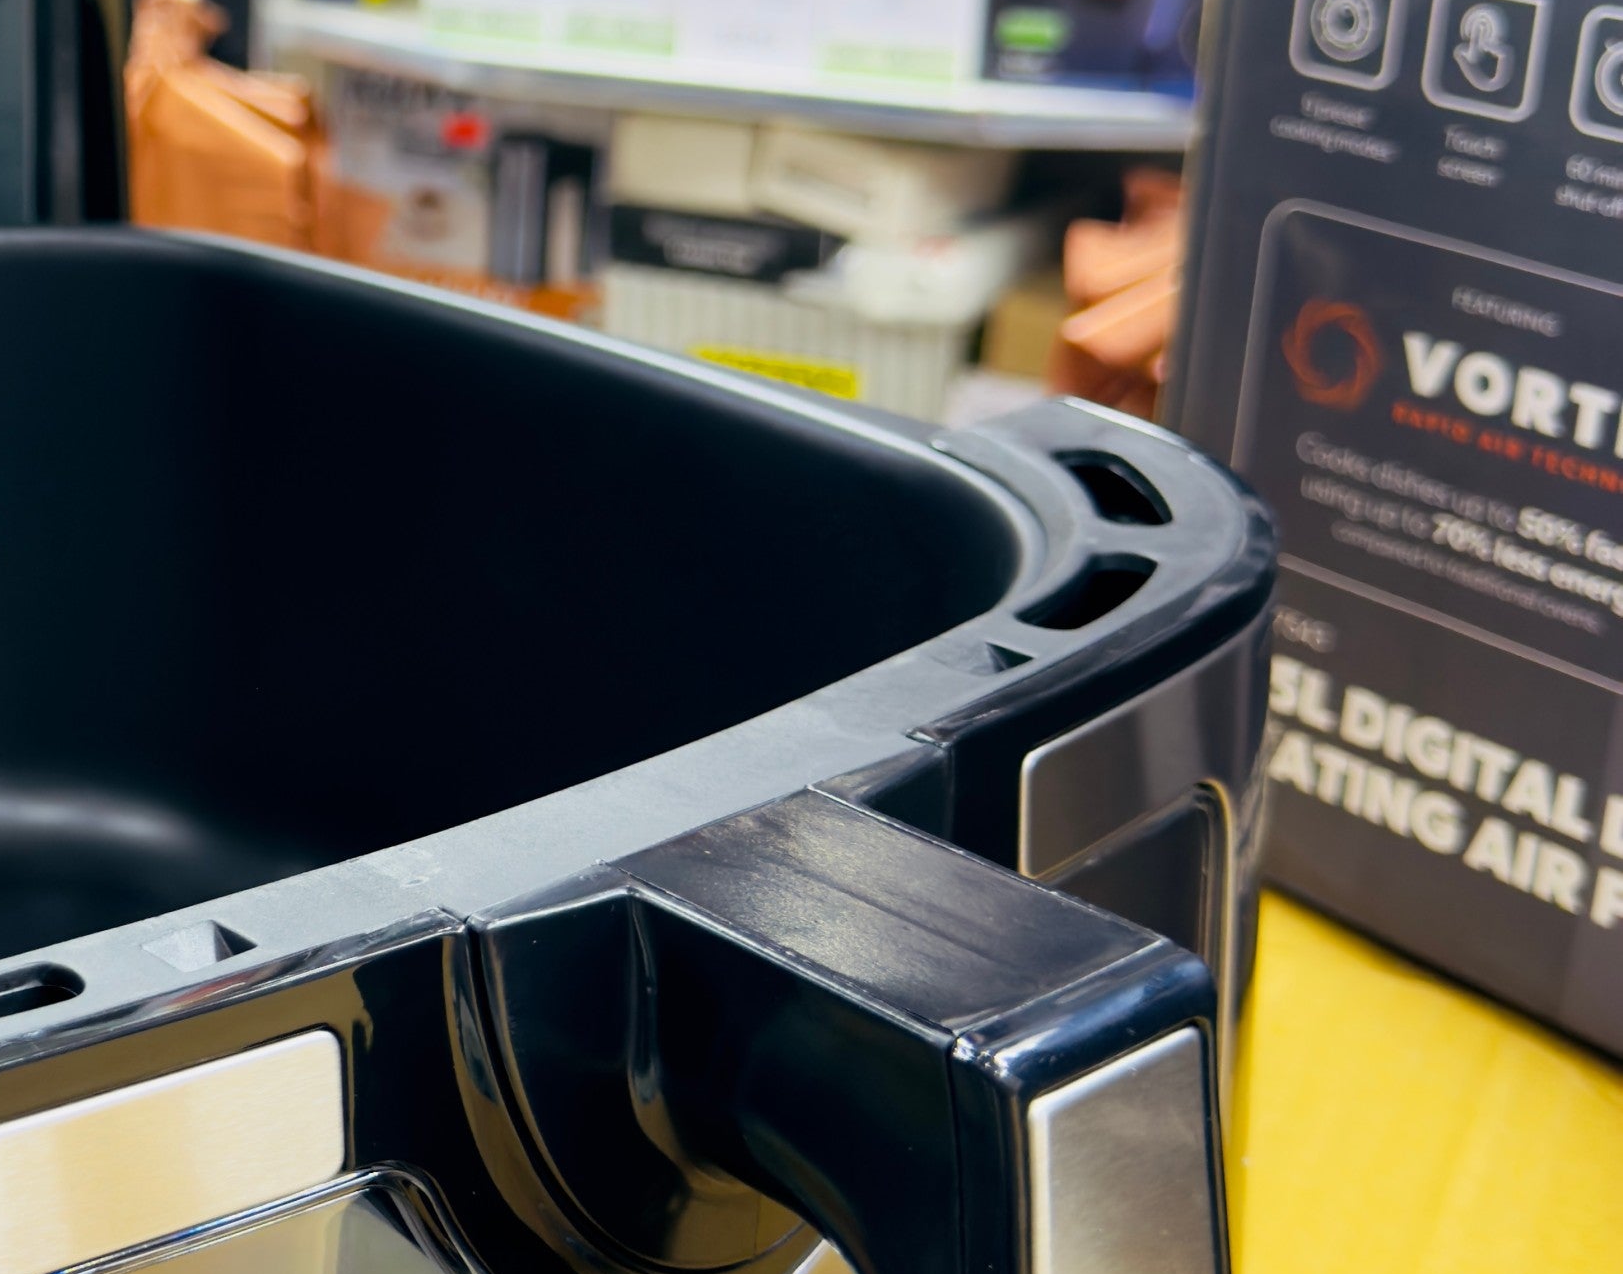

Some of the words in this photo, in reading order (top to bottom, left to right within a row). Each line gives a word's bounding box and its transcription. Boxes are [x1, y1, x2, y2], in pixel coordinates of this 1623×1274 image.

[1403, 330, 1623, 460] VORT
[1530, 444, 1623, 494] TECHN
[1339, 685, 1594, 845] DIGITAL
[1462, 816, 1587, 915] AIR
